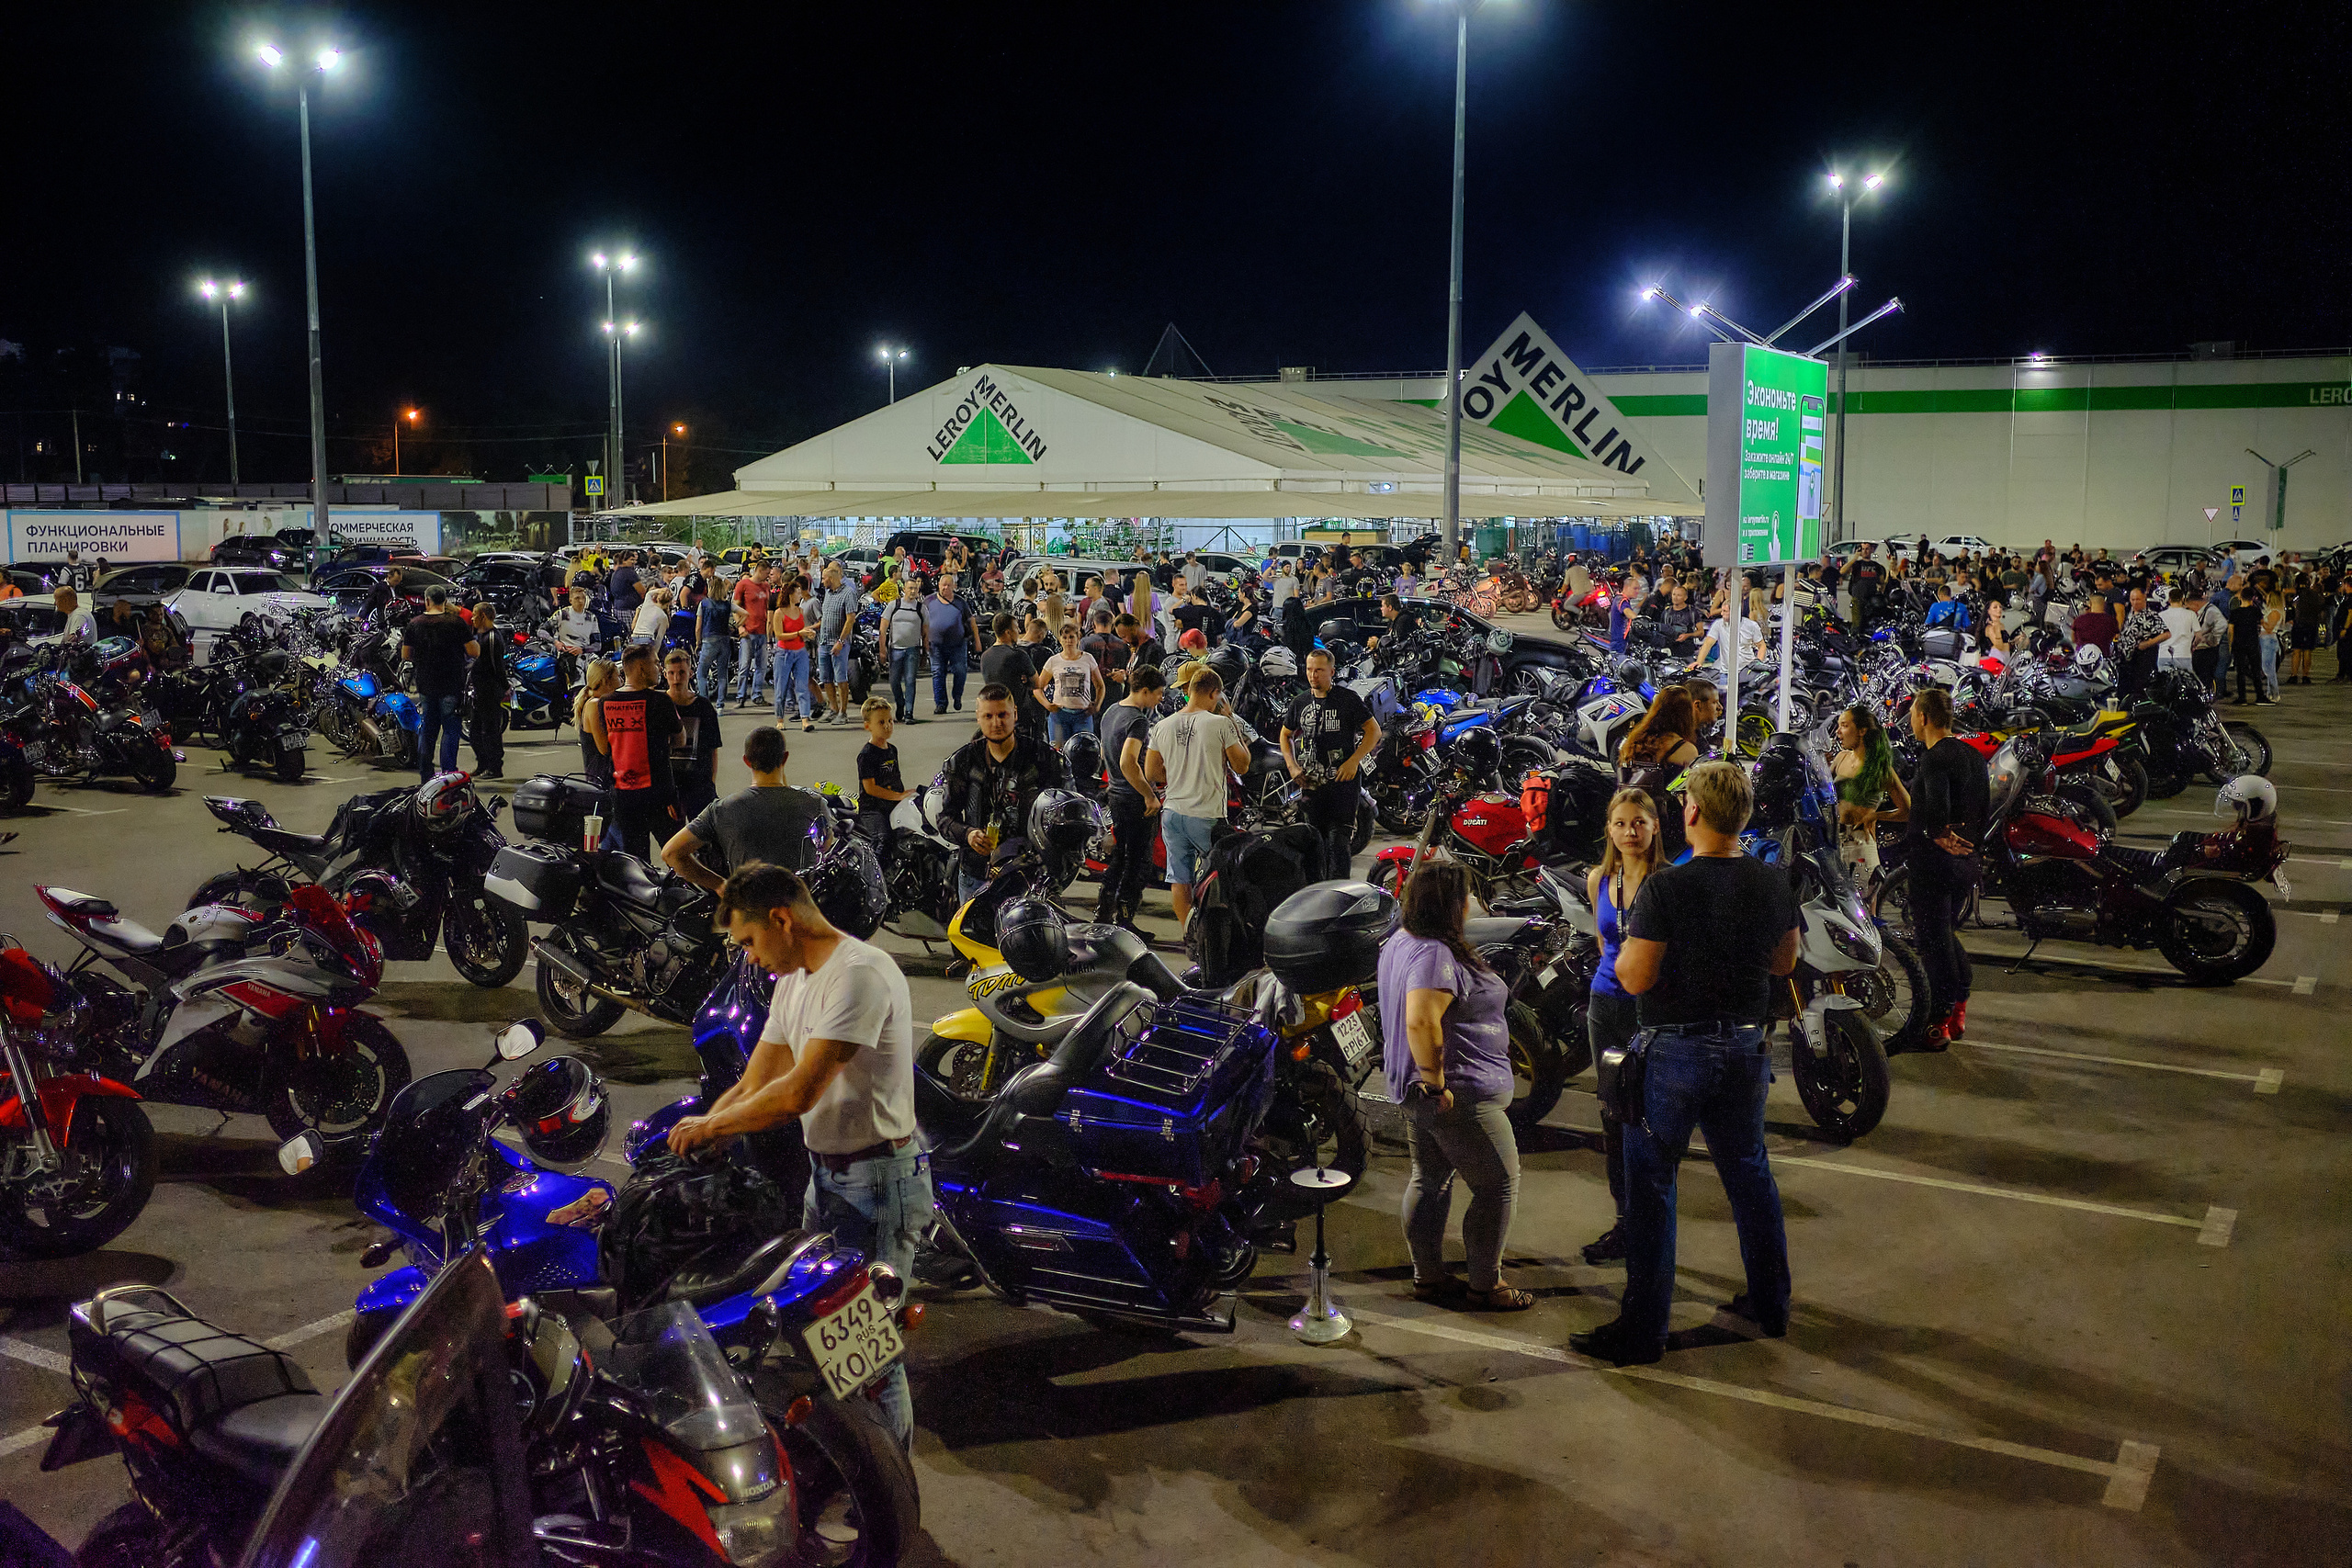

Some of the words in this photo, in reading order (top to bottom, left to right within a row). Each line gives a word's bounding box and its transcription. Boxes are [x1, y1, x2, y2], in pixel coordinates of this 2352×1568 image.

[1501, 331, 1645, 475] MERLIN
[1747, 379, 1796, 412] Экономьте
[926, 389, 980, 461] LEROY
[975, 374, 1047, 462] MERLIN
[1746, 417, 1779, 445] время!
[26, 525, 165, 538] ФУНКЦИОНАЛЬНЫЕ
[330, 522, 414, 533] ОММЕРЧЕСКАЯ
[28, 541, 128, 553] ПЛАНИРОВКИ
[74, 573, 85, 592] 6
[606, 717, 625, 728] WR
[1325, 709, 1338, 720] FLY
[247, 982, 271, 998] YAMAHA
[1337, 1014, 1358, 1038] 1223
[1356, 1031, 1369, 1047] 61
[820, 1298, 873, 1351] 6349
[855, 1324, 876, 1343] RUS
[867, 1326, 897, 1363] 23
